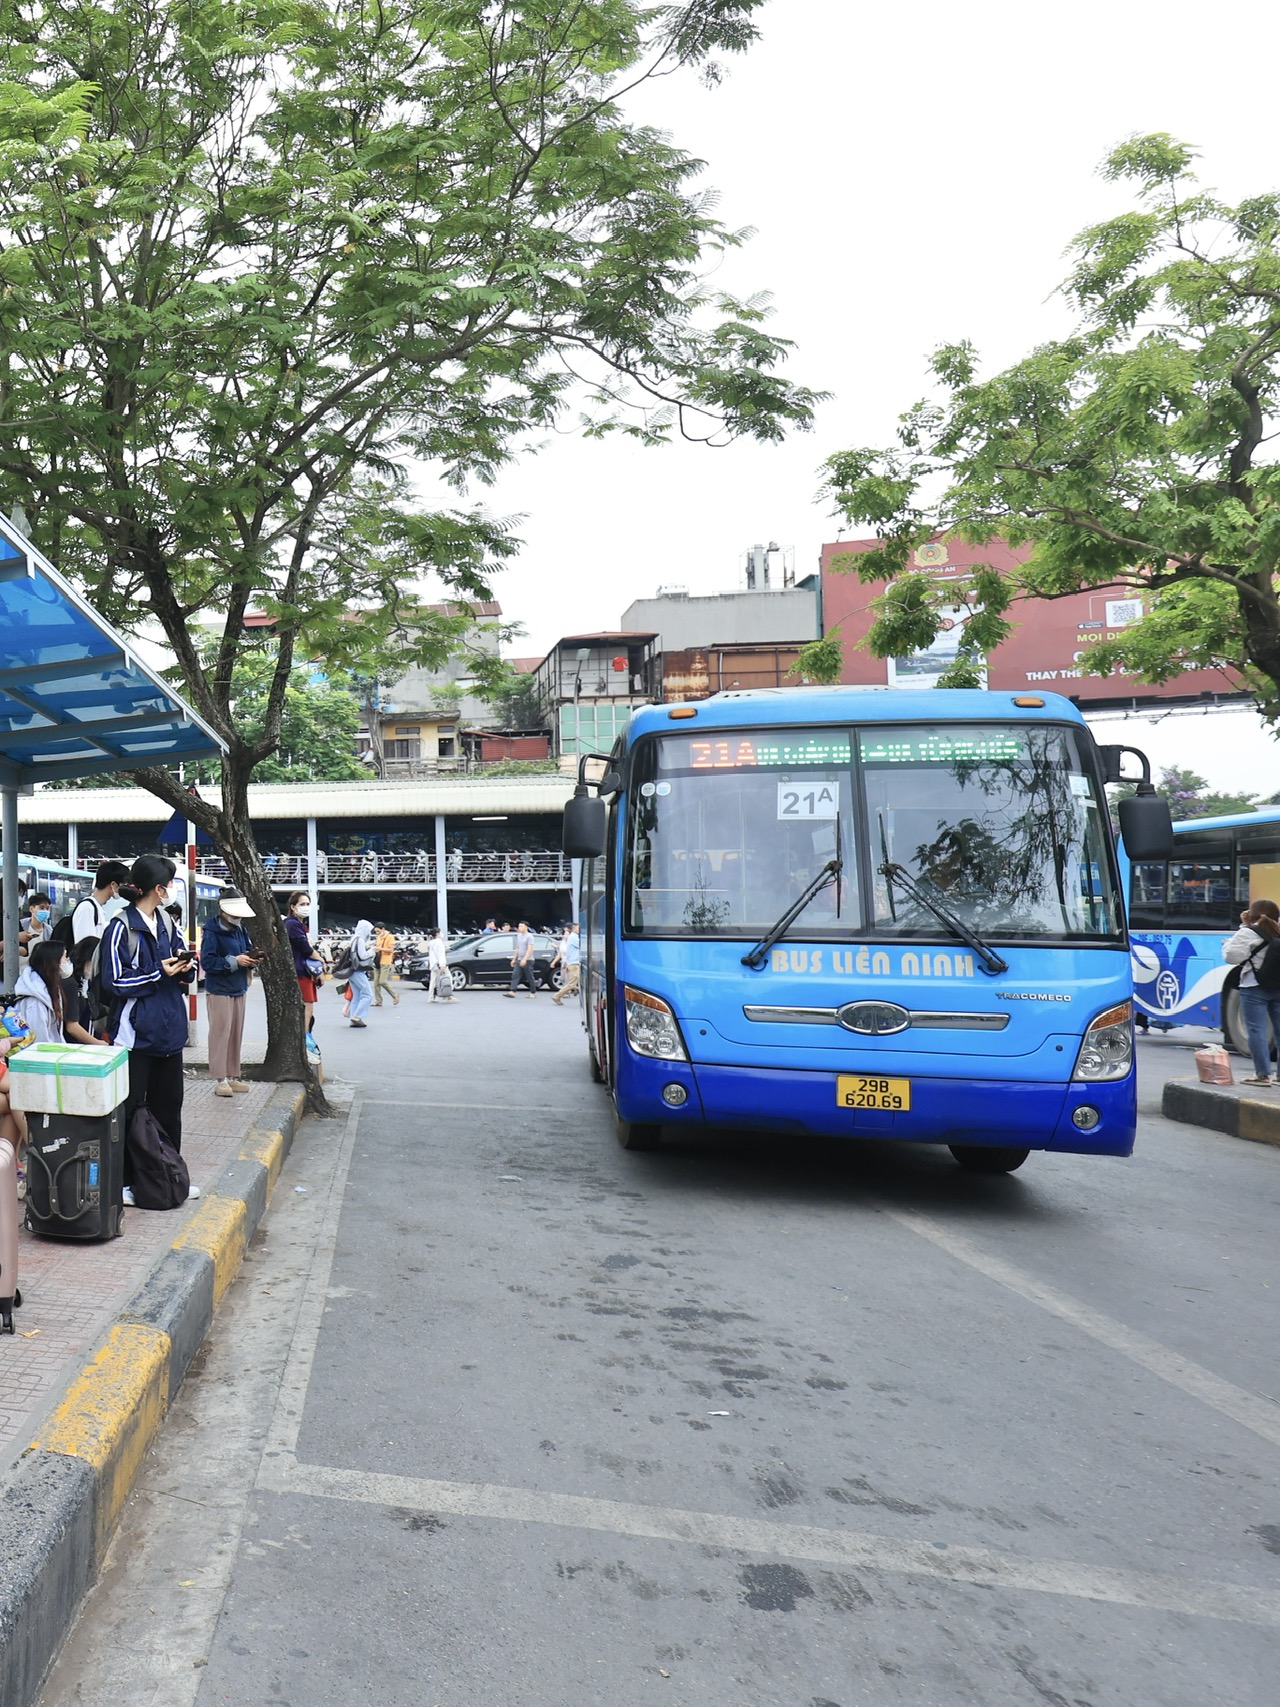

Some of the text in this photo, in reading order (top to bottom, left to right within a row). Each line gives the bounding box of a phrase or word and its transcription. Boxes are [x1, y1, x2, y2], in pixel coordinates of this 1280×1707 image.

[1077, 632, 1102, 643] MỌI
[1026, 669, 1058, 681] THAY
[783, 787, 834, 815] 21A
[772, 945, 975, 977] BUS LIÊN NINH
[995, 991, 1073, 1002] TRACOMECO
[858, 1079, 889, 1093] 29B
[845, 1093, 902, 1109] 620.69
